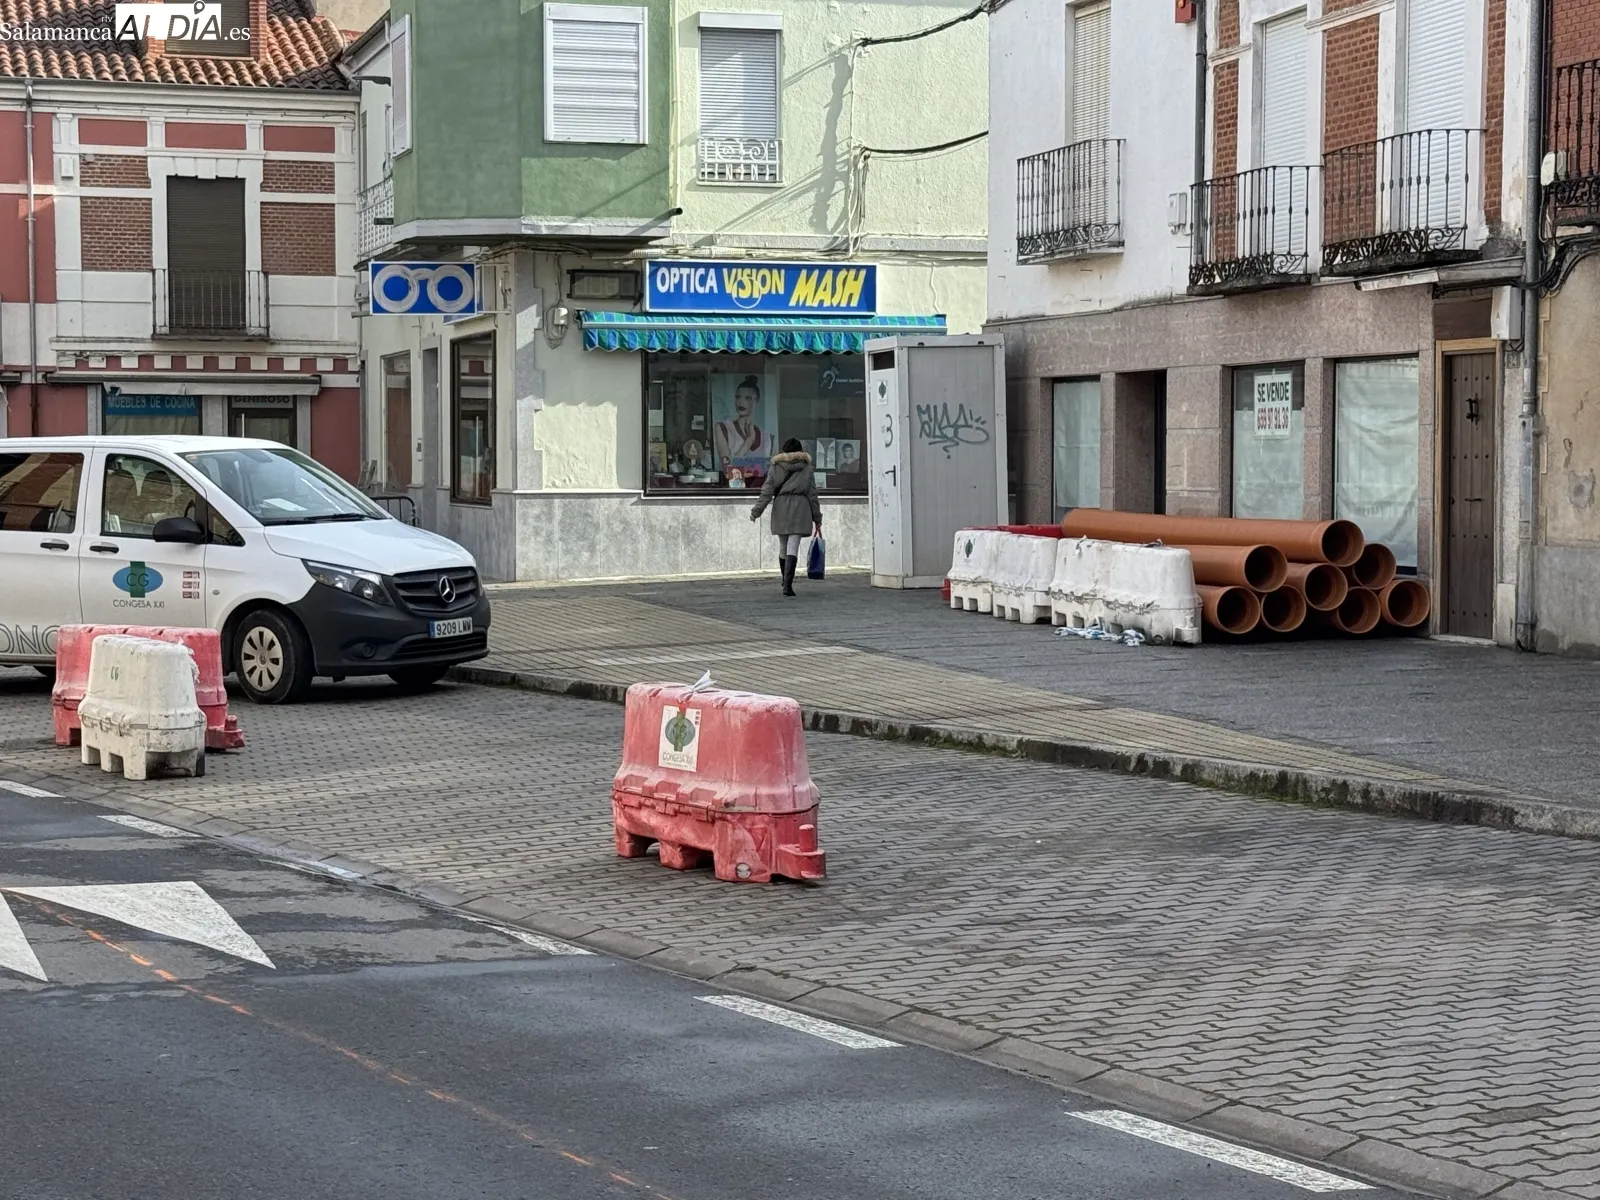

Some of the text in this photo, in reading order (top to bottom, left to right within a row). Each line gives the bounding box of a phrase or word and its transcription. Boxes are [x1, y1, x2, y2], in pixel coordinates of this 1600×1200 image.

[656, 266, 867, 308] OPTICA VISION MASH
[234, 395, 290, 404] GENEROSO
[1257, 381, 1290, 403] SE VENDE
[107, 395, 195, 409] MUEBLES DE COCINA
[126, 572, 150, 587] CG
[112, 599, 165, 608] CONGESA XXI
[436, 621, 457, 636] 9209
